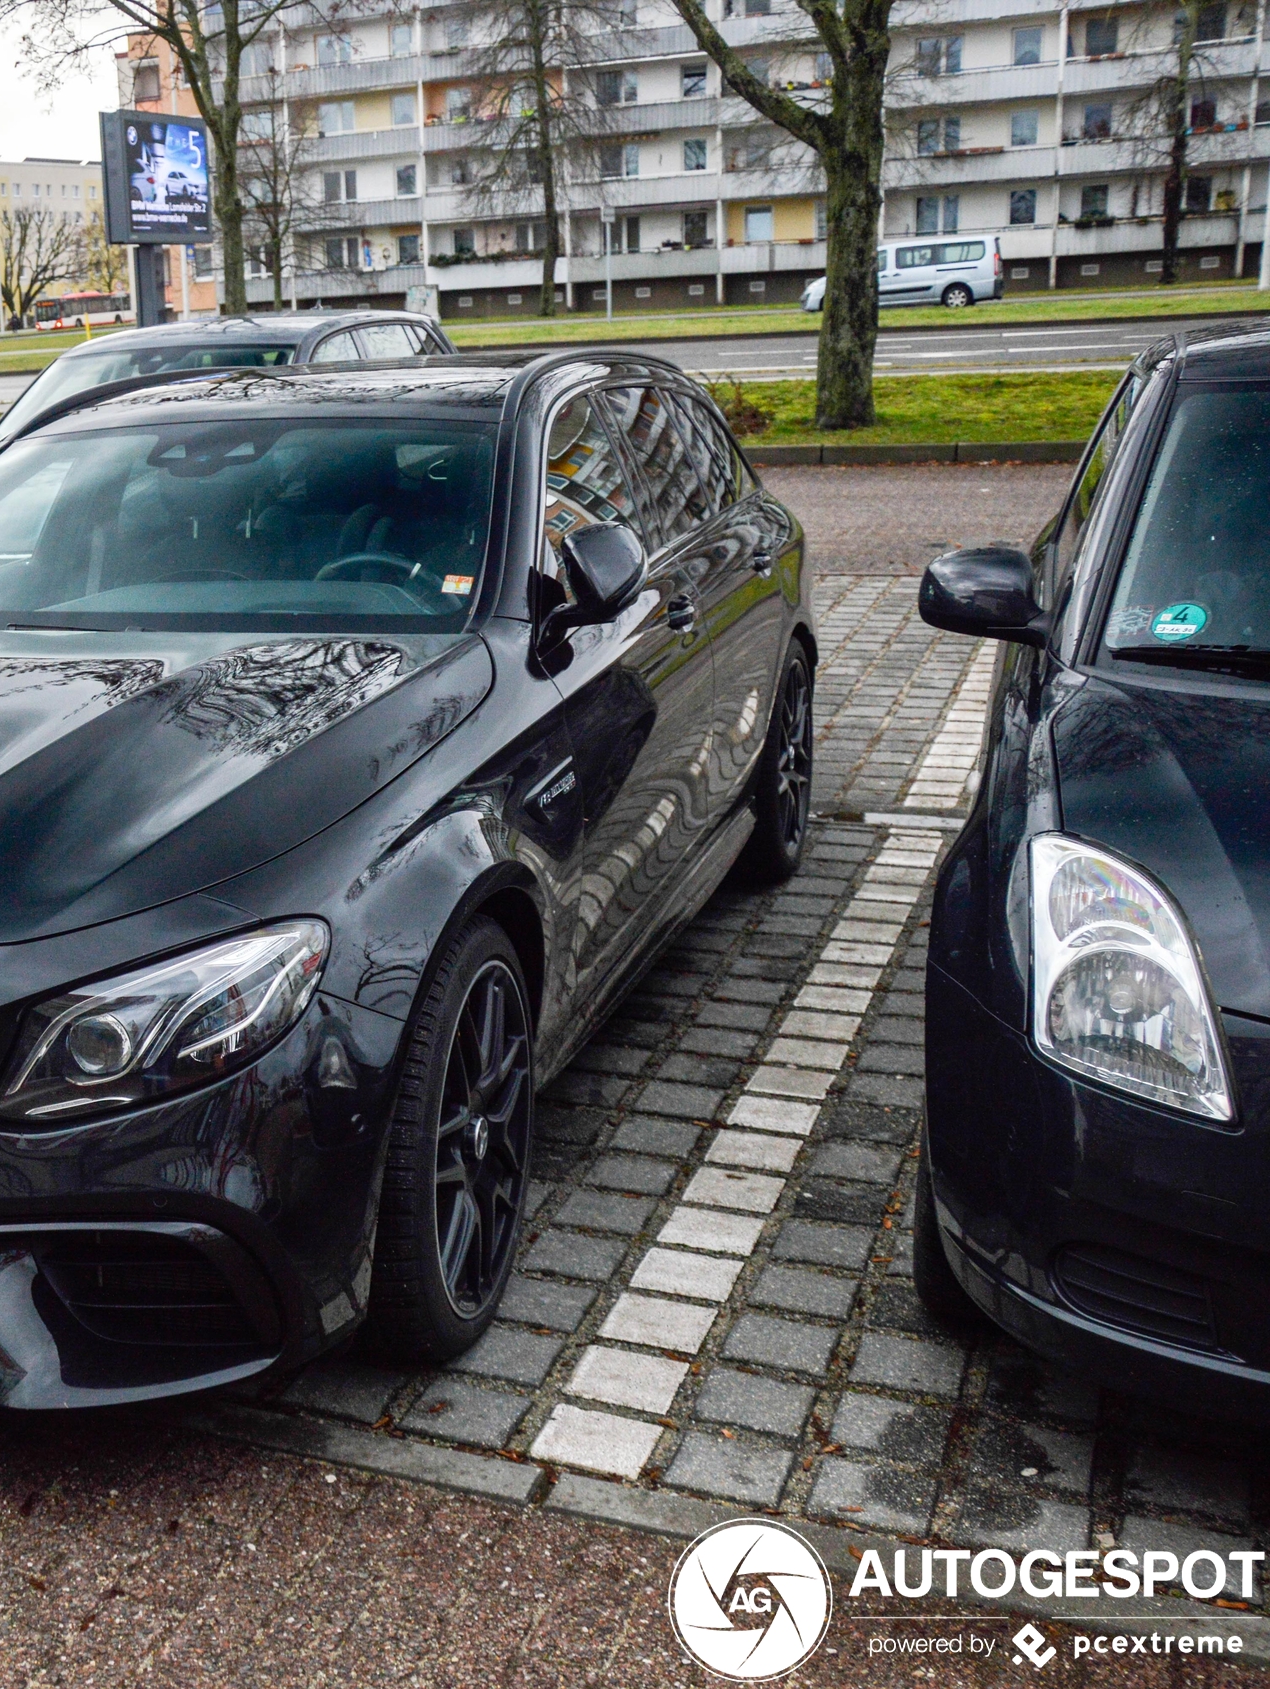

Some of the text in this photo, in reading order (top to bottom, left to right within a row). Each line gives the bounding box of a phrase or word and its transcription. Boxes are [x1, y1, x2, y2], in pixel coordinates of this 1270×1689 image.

[188, 131, 201, 168] 5
[131, 200, 145, 210] BMW
[1172, 606, 1190, 623] 4
